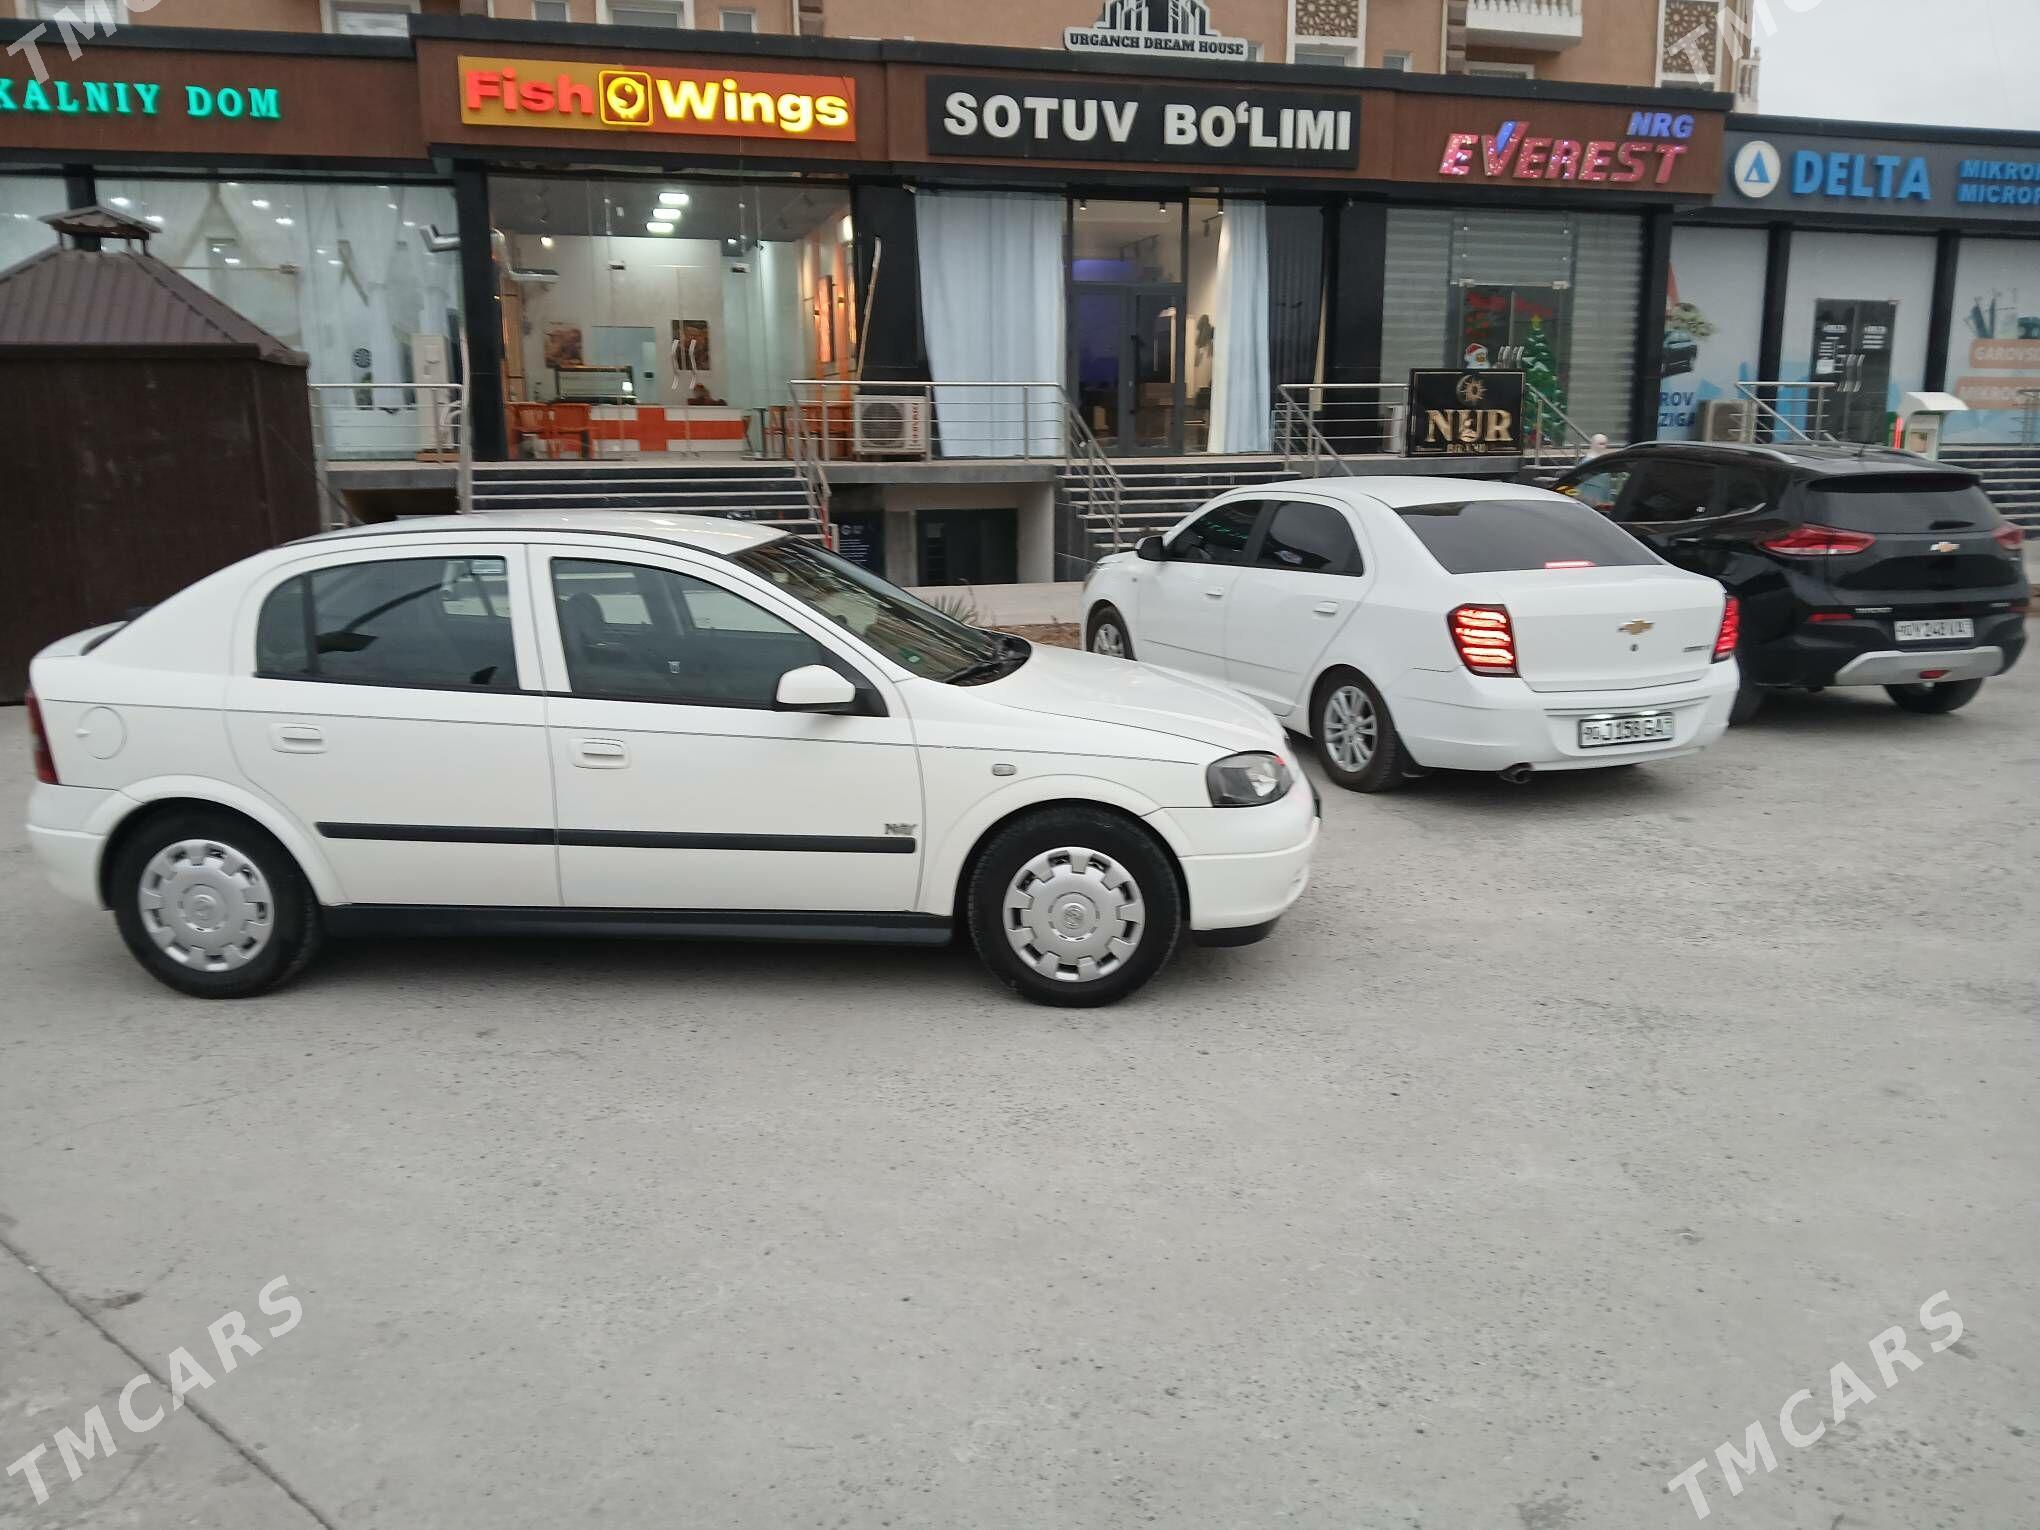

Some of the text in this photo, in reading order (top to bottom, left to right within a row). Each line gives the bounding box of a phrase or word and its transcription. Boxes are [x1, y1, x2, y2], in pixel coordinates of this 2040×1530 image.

[1070, 33, 1244, 56] URGANCH DREAM HOUSE
[185, 86, 281, 119] DOM
[464, 67, 850, 133] Fish Wings
[943, 92, 1139, 142] SOTUV
[1627, 111, 1696, 139] NRG
[1439, 120, 1688, 184] EVEREST
[1791, 150, 1932, 200] DELTA
[1424, 409, 1514, 443] NUR
